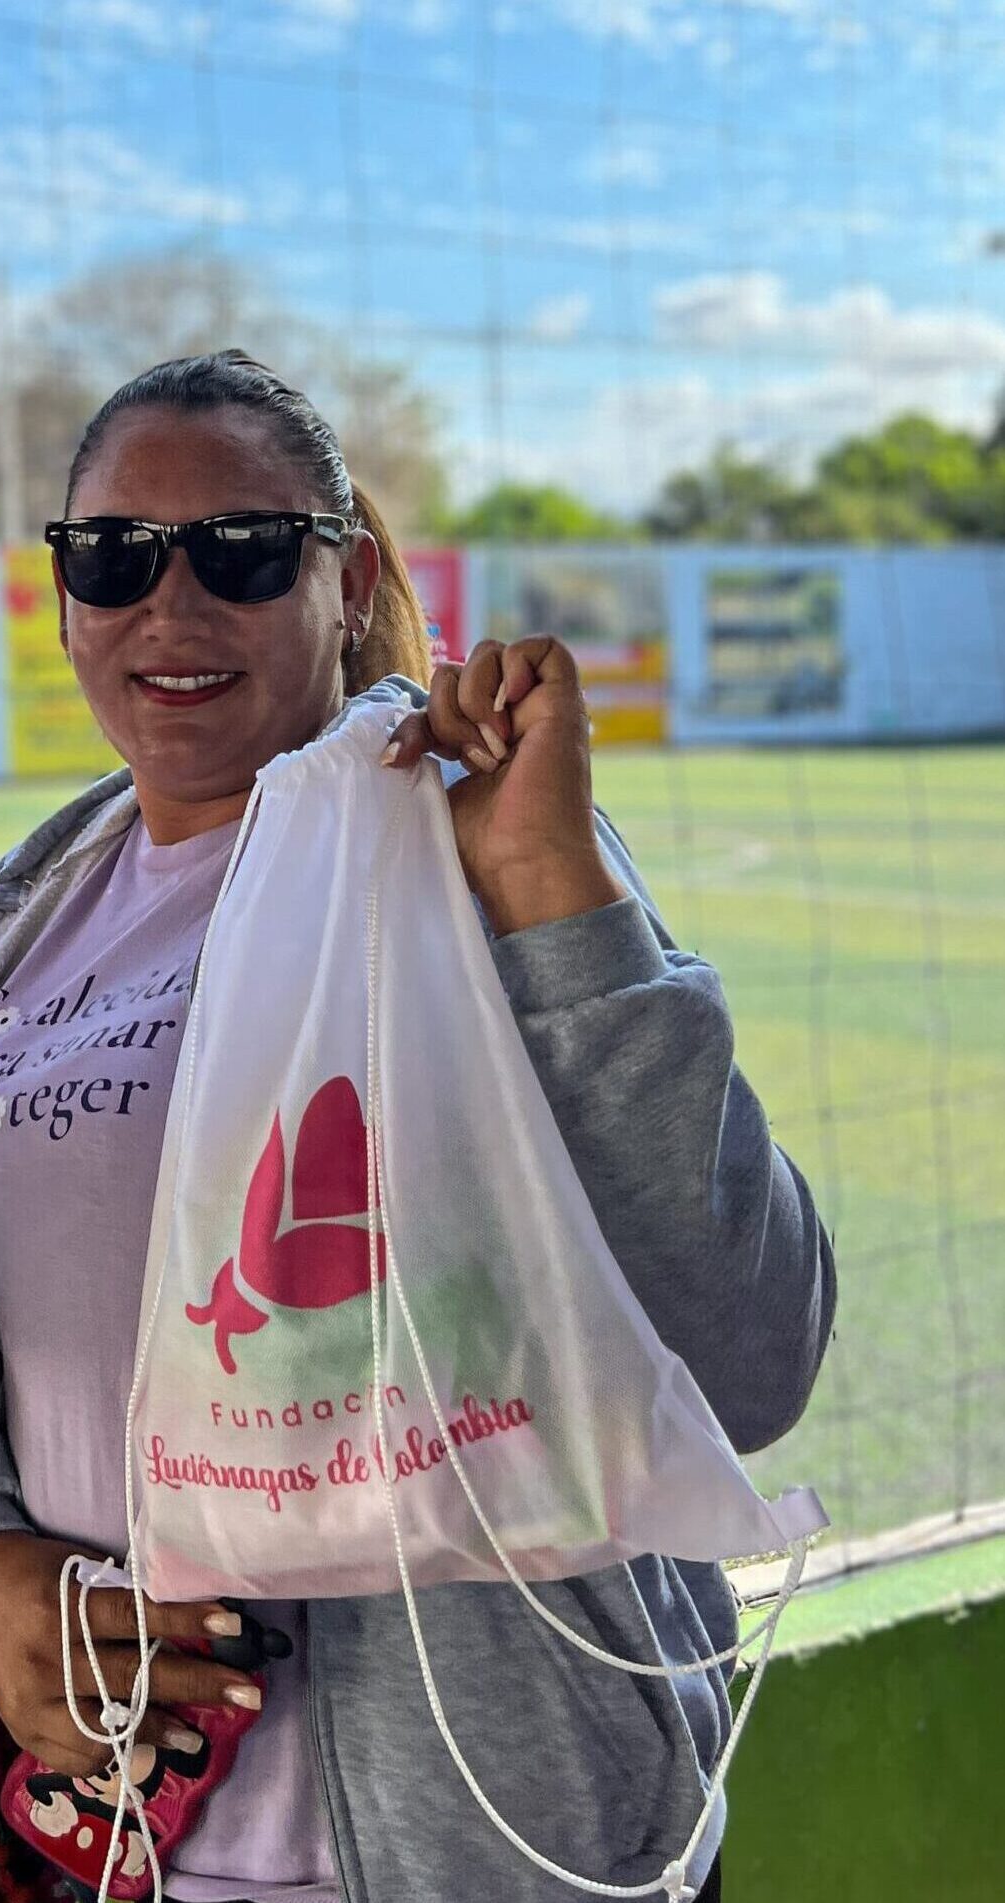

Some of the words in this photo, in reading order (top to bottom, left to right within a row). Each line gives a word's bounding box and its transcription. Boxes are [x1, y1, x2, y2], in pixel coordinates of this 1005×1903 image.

[209, 1384, 407, 1430] Fundacin
[142, 1434, 320, 1513] Luciérnagas
[326, 1437, 371, 1485] de
